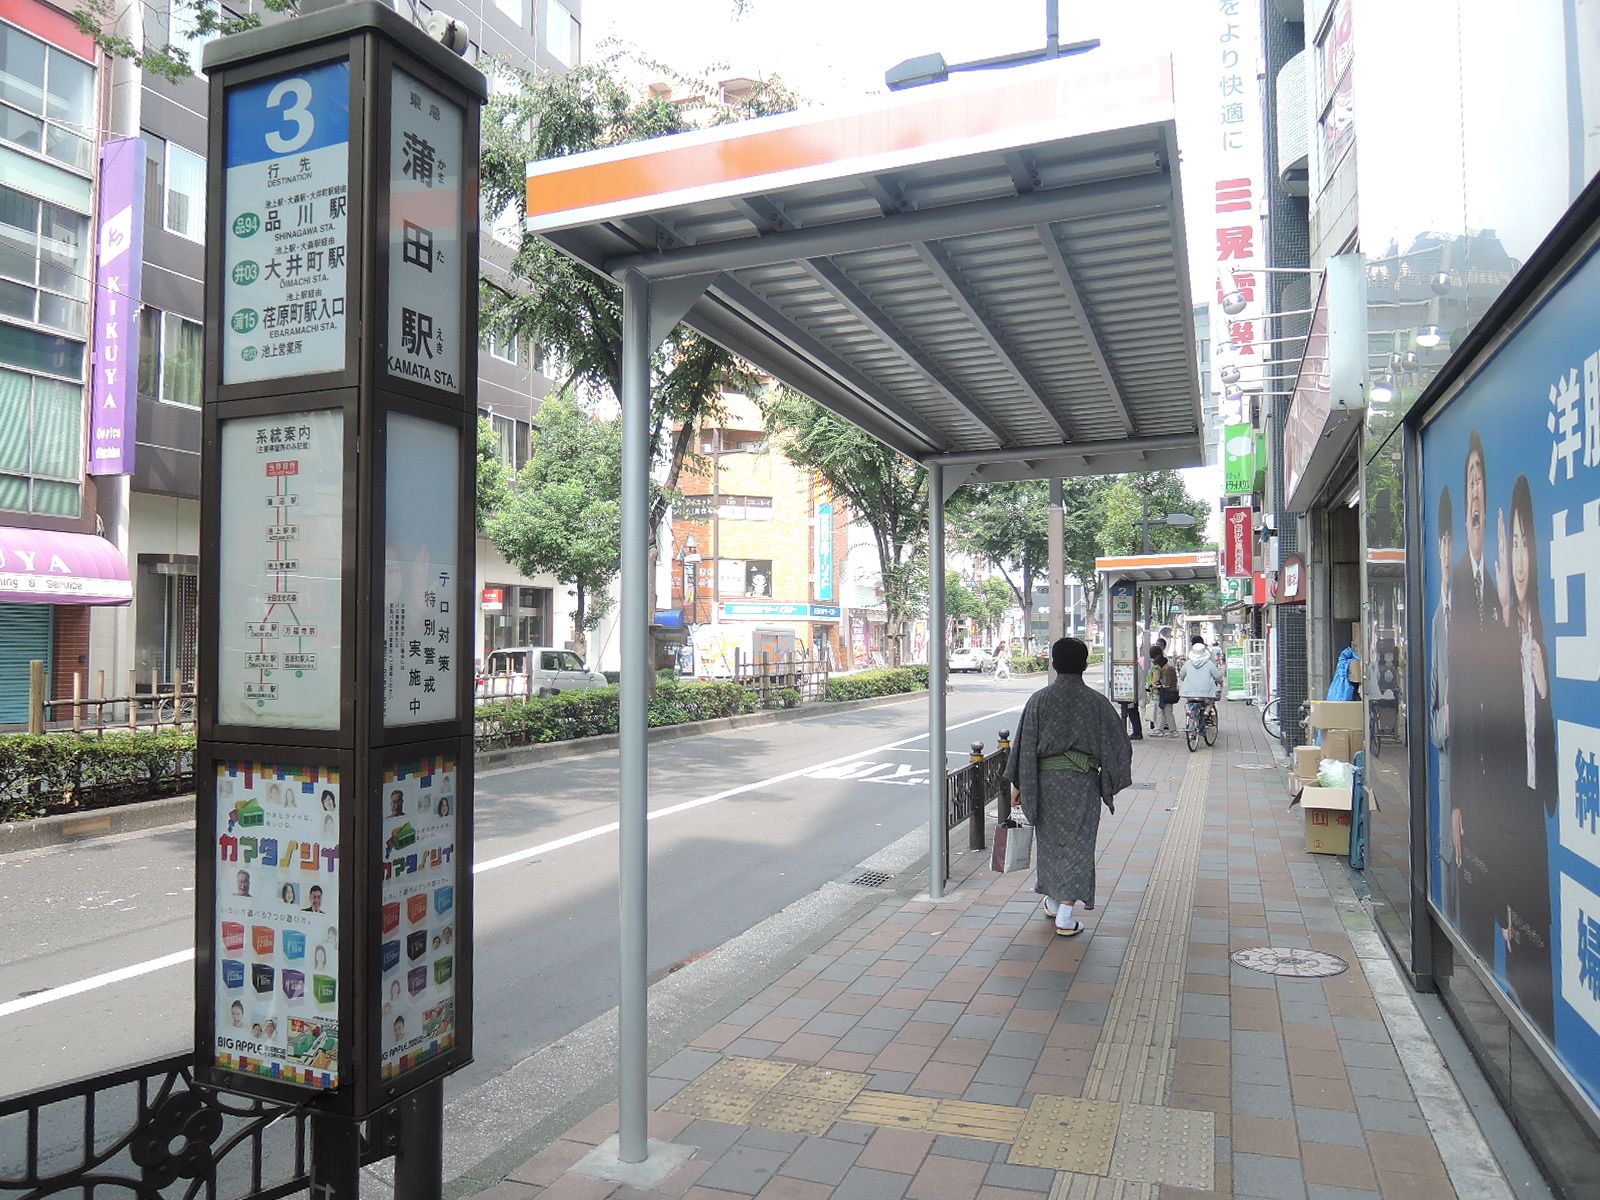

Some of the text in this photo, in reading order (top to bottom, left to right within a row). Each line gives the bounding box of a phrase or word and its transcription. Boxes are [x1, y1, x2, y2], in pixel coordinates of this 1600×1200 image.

[265, 78, 314, 154] 3
[268, 157, 311, 179] 行先
[268, 172, 312, 188] DESTINATION
[265, 195, 346, 232] 品川駅
[235, 216, 258, 234] 品94
[275, 223, 336, 241] SHINAGAWA STA.
[402, 130, 435, 360] 蒲田駅
[234, 264, 257, 282] 井03
[264, 245, 345, 280] 大井町駅
[312, 274, 329, 283] STA.
[286, 288, 322, 301] 池上駅経由
[233, 312, 255, 330] 蒲15
[262, 297, 344, 329] 荏原町駅入口
[269, 322, 338, 338] EBARAMACHI STA.
[435, 327, 444, 355] えき
[103, 276, 120, 409] KIKUYA
[261, 340, 303, 359] 池上営業所
[387, 355, 457, 389] KAMATA STA.
[256, 425, 310, 444] 系統案内
[0, 548, 72, 574] YA
[1118, 587, 1126, 596] 2
[438, 572, 450, 672] テロ対策
[423, 590, 436, 693] 特別警戒
[408, 640, 421, 716] 実施中
[217, 1036, 234, 1049] BIG
[235, 1039, 263, 1056] APPLE
